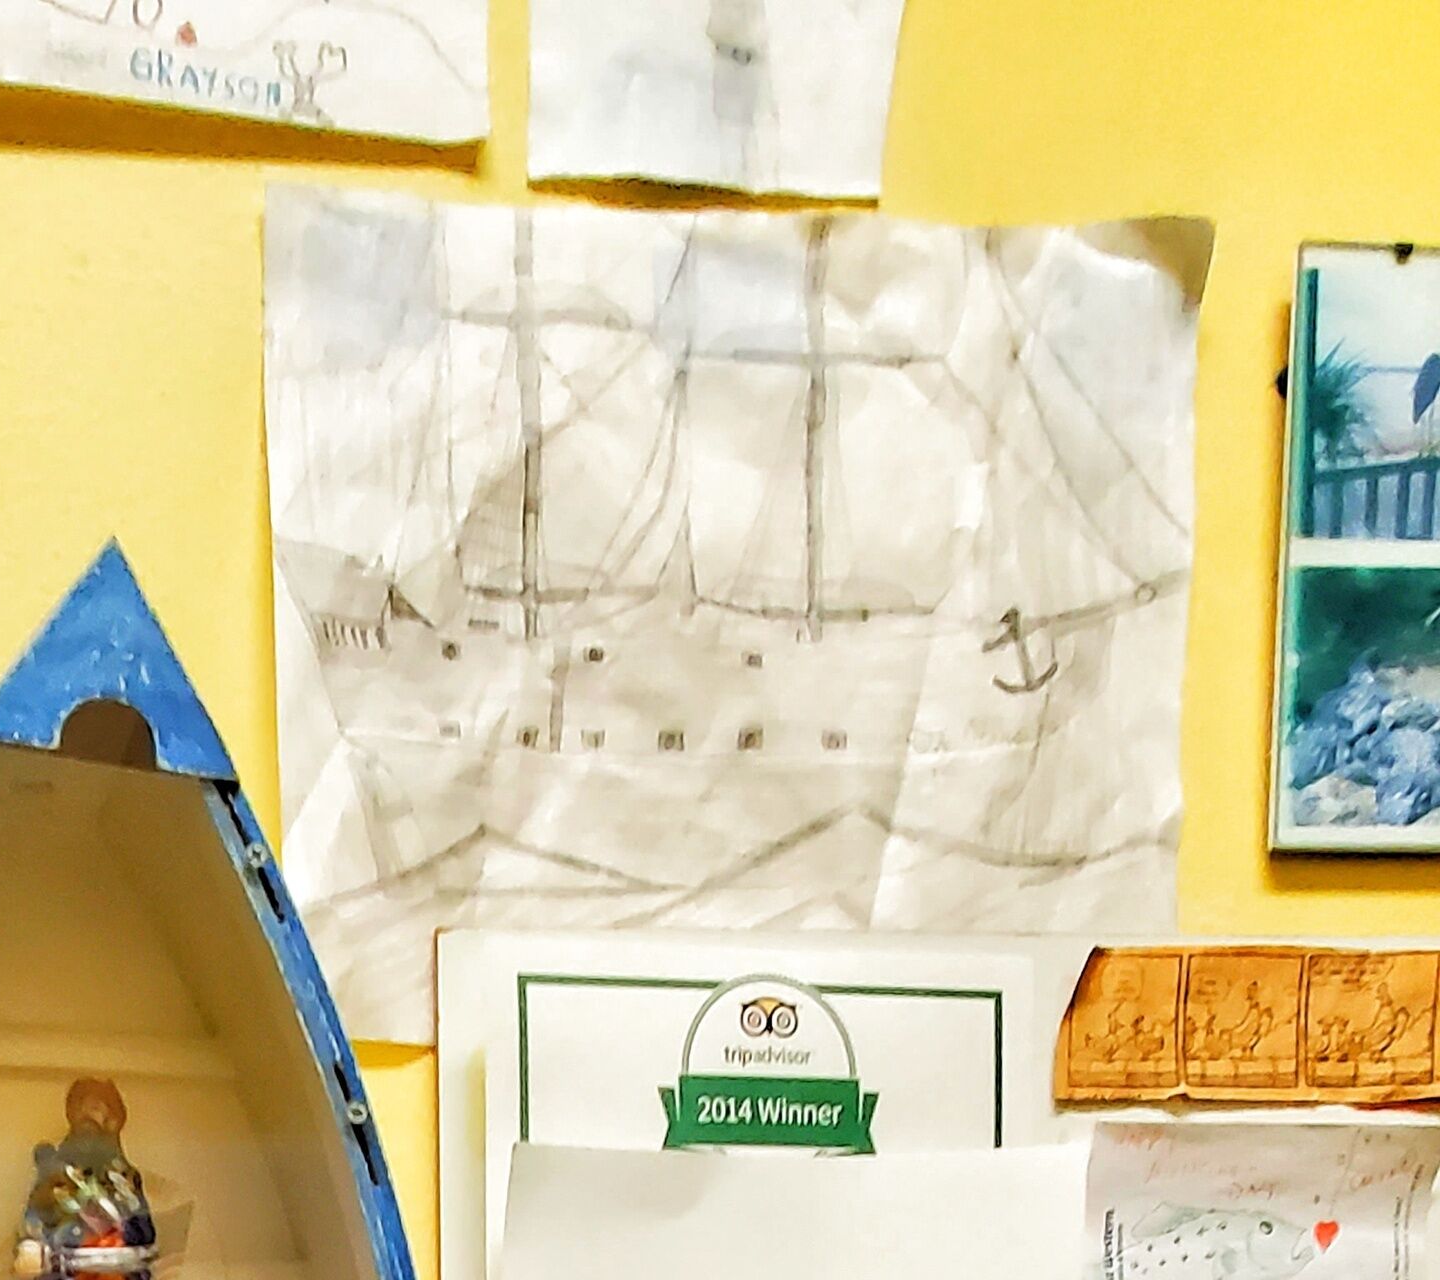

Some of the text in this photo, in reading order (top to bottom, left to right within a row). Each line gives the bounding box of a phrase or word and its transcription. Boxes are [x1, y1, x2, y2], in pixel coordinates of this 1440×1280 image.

[129, 47, 281, 107] GRAYSON
[722, 1044, 812, 1068] tripadvisor
[696, 1095, 845, 1129] 2014 Winner
